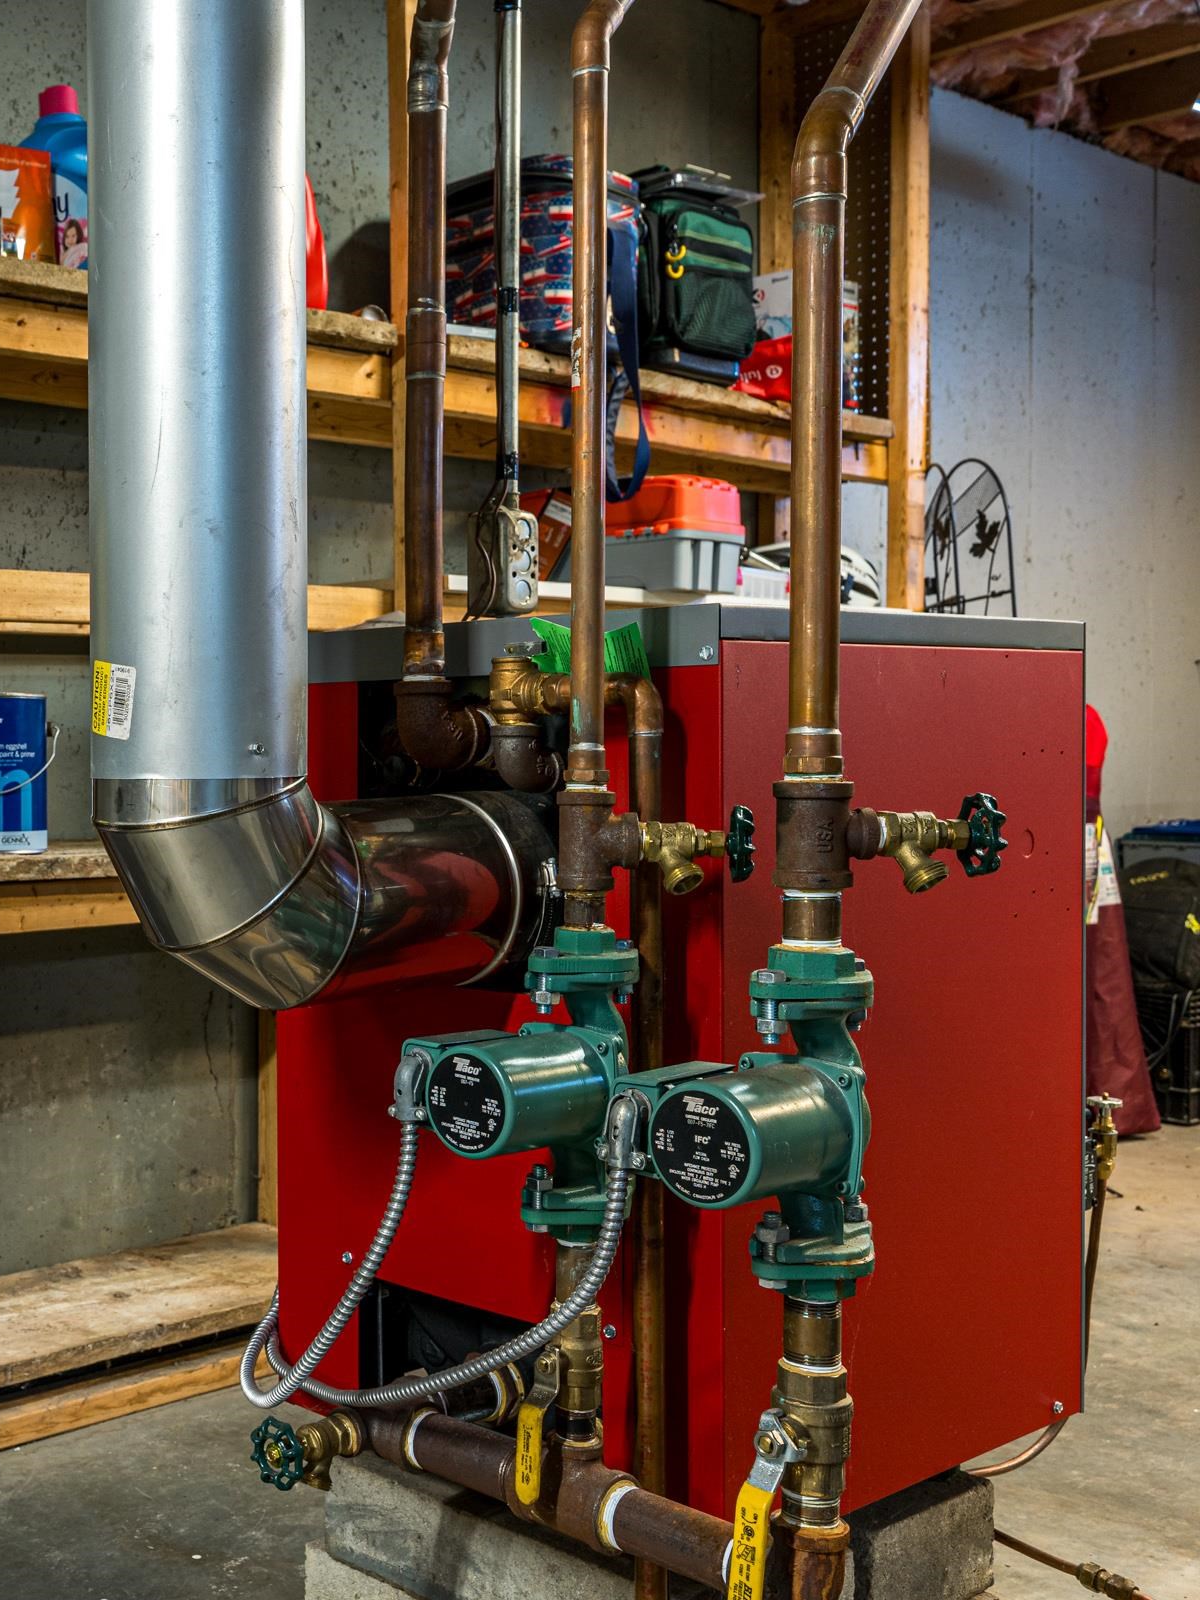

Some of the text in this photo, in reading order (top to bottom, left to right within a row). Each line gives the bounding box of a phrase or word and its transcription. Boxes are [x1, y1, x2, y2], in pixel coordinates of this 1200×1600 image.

[6, 743, 27, 751] eggshell
[816, 818, 834, 852] USA
[453, 1057, 479, 1075] Taco
[682, 1095, 716, 1116] Taco
[694, 1134, 708, 1144] IFC
